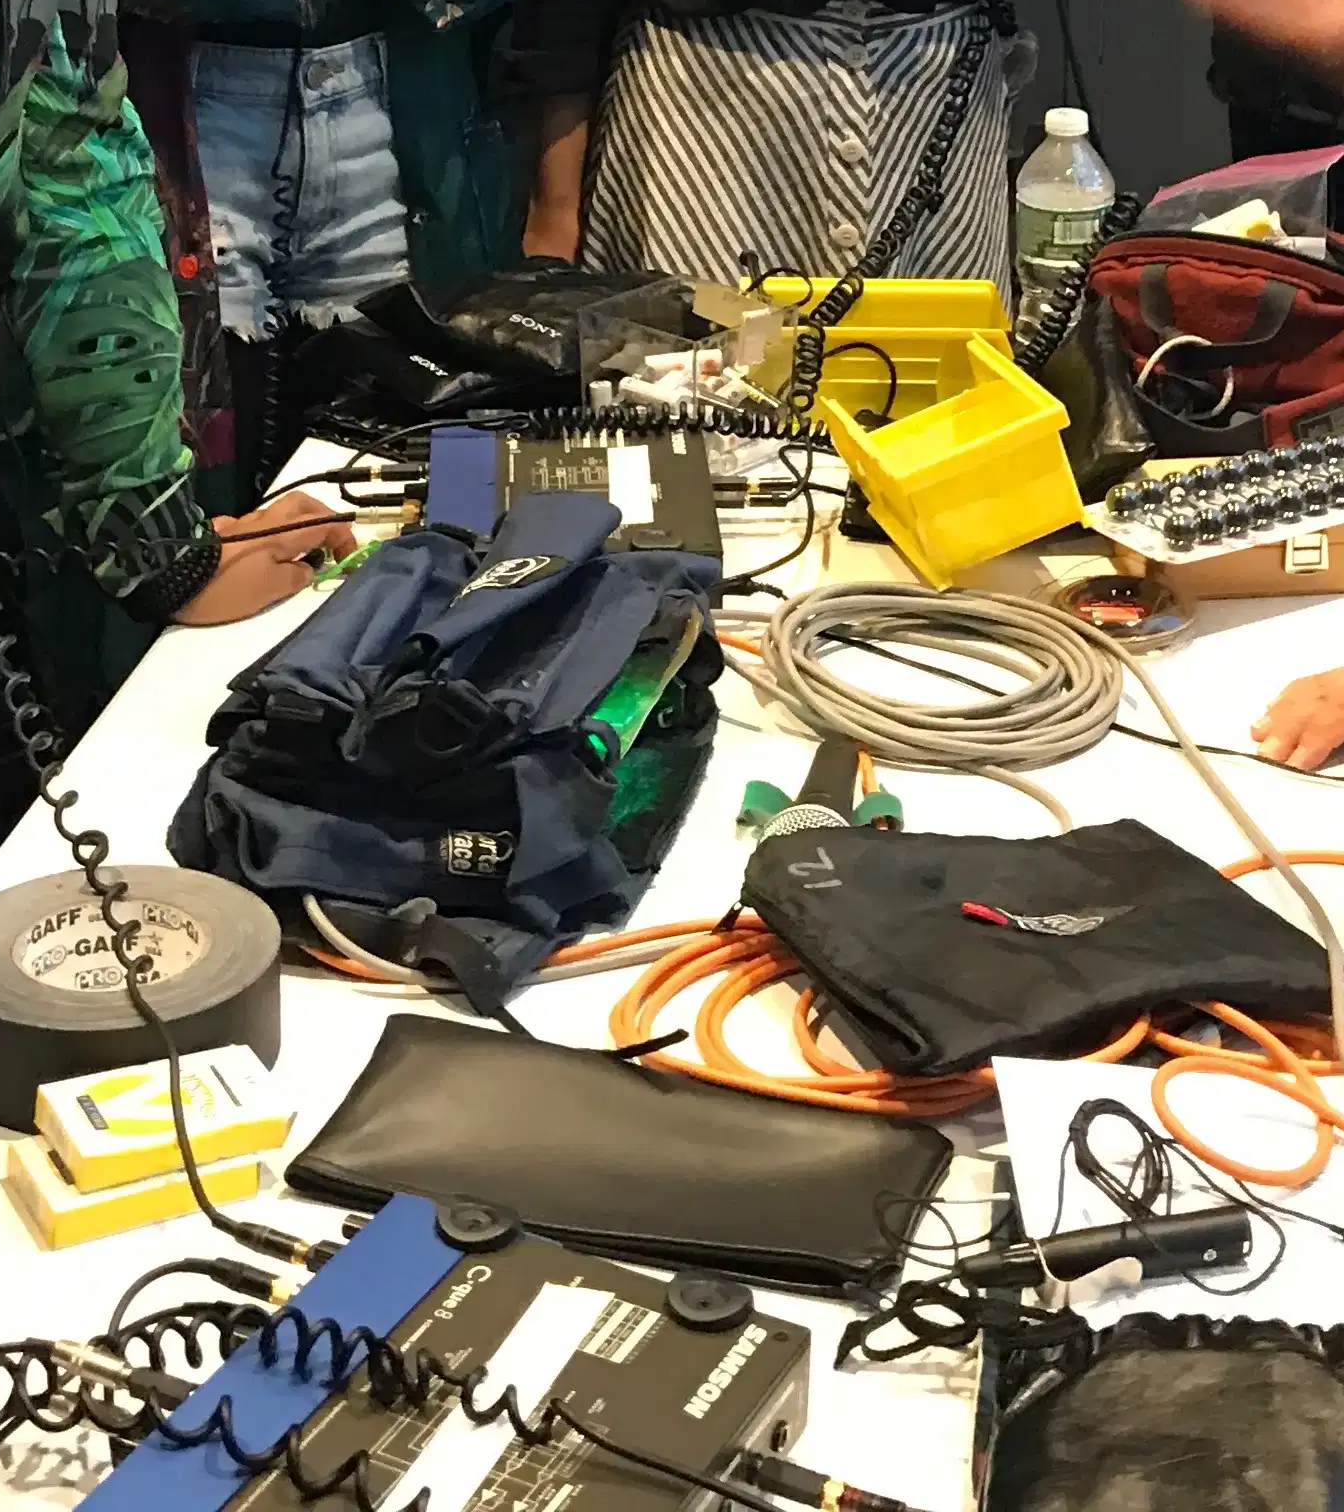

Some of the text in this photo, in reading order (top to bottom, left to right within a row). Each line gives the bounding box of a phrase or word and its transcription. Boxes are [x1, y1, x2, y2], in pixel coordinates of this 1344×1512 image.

[509, 313, 562, 338] SONY
[408, 354, 449, 377] SONY
[453, 832, 474, 870] race
[478, 834, 500, 873] orta
[433, 1308, 454, 1320] 8
[682, 1322, 769, 1420] SAMSON
